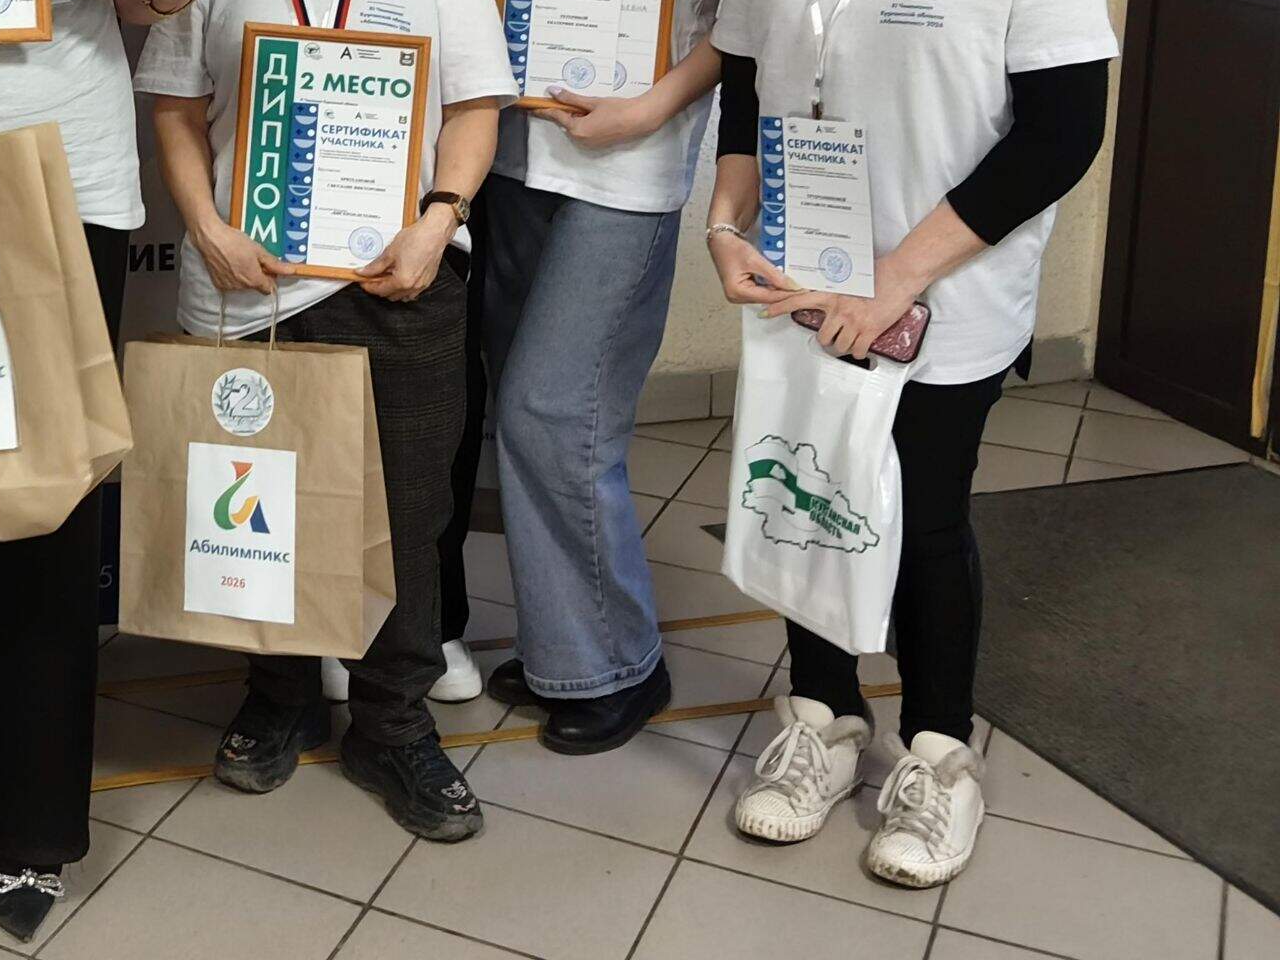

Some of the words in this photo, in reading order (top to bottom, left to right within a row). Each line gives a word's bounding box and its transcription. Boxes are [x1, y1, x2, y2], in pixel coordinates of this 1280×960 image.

[300, 72, 314, 90] 2
[323, 73, 411, 98] МЕСТО
[321, 124, 407, 140] СЕРТИФИКАТ
[250, 53, 288, 244] ДИПЛОМ
[321, 136, 384, 150] УЧАСТНИКА
[787, 138, 864, 155] СЕРТИФИКАТ
[788, 151, 846, 165] УЧАСТНИКА
[130, 244, 175, 272] ИЕ
[190, 539, 290, 564] Абилимпикс
[220, 575, 246, 590] 2026
